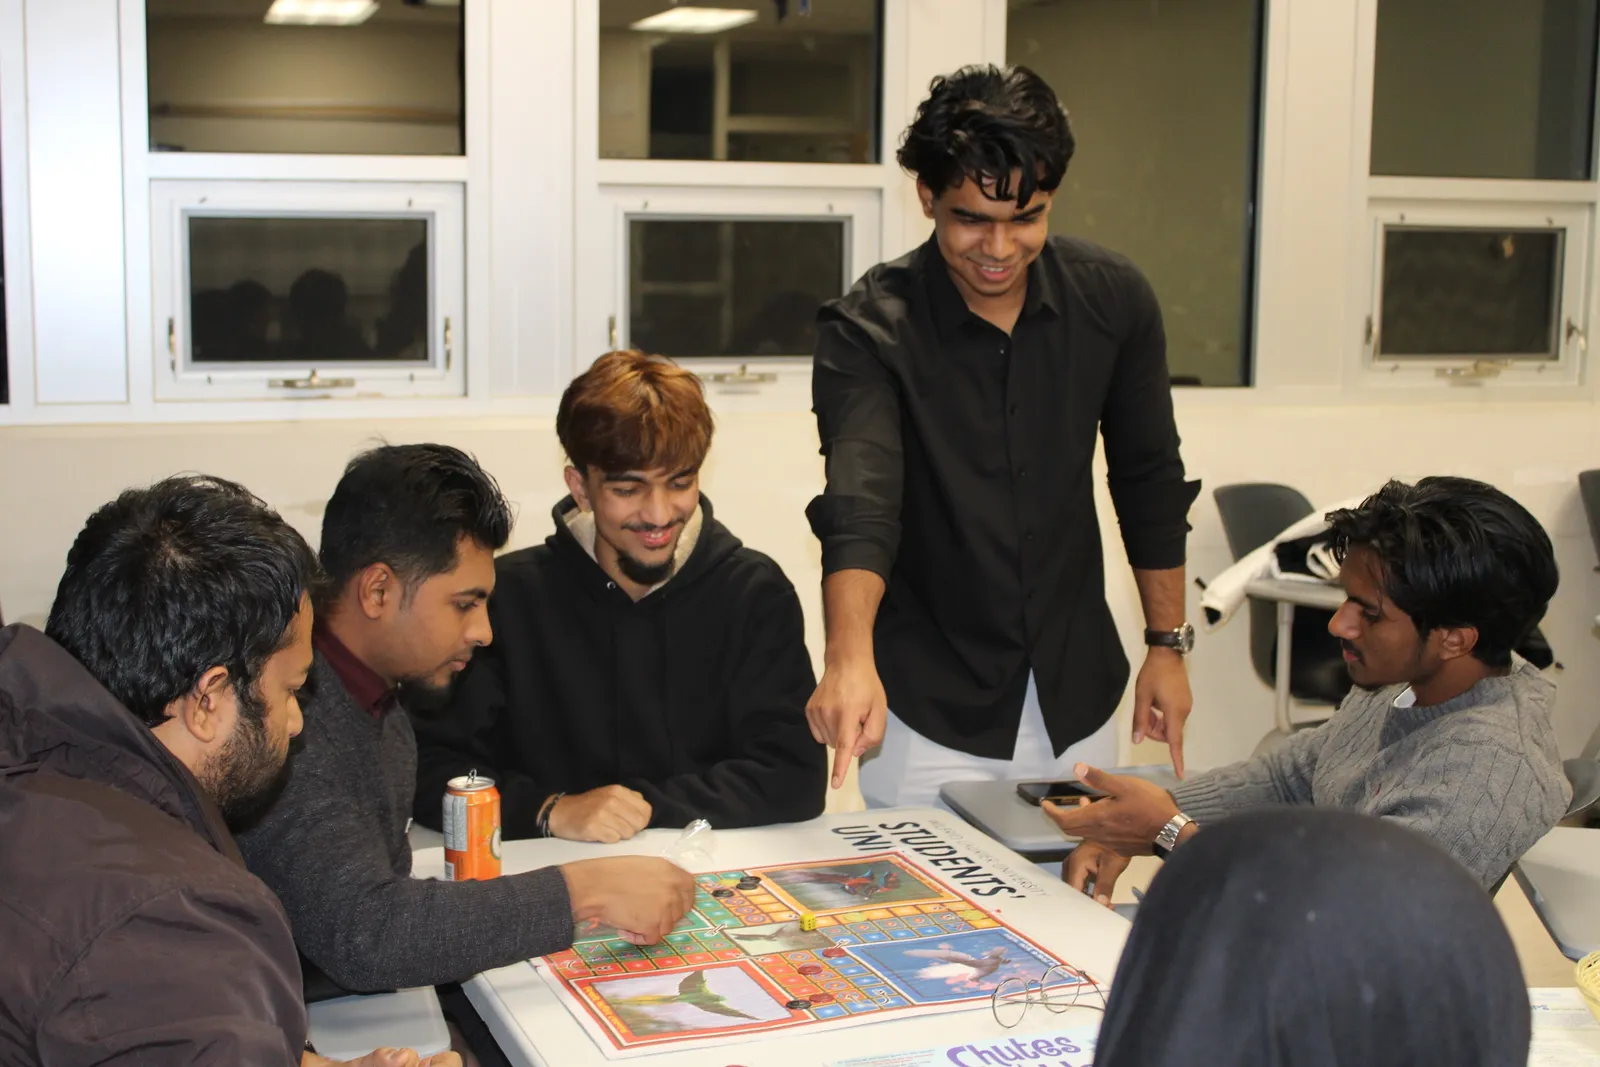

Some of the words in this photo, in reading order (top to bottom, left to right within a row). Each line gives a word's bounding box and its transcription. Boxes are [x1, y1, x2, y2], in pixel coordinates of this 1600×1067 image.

[831, 825, 898, 851] UNI
[878, 821, 1027, 899] STUDENTS'
[946, 1036, 1081, 1067] Chutes
